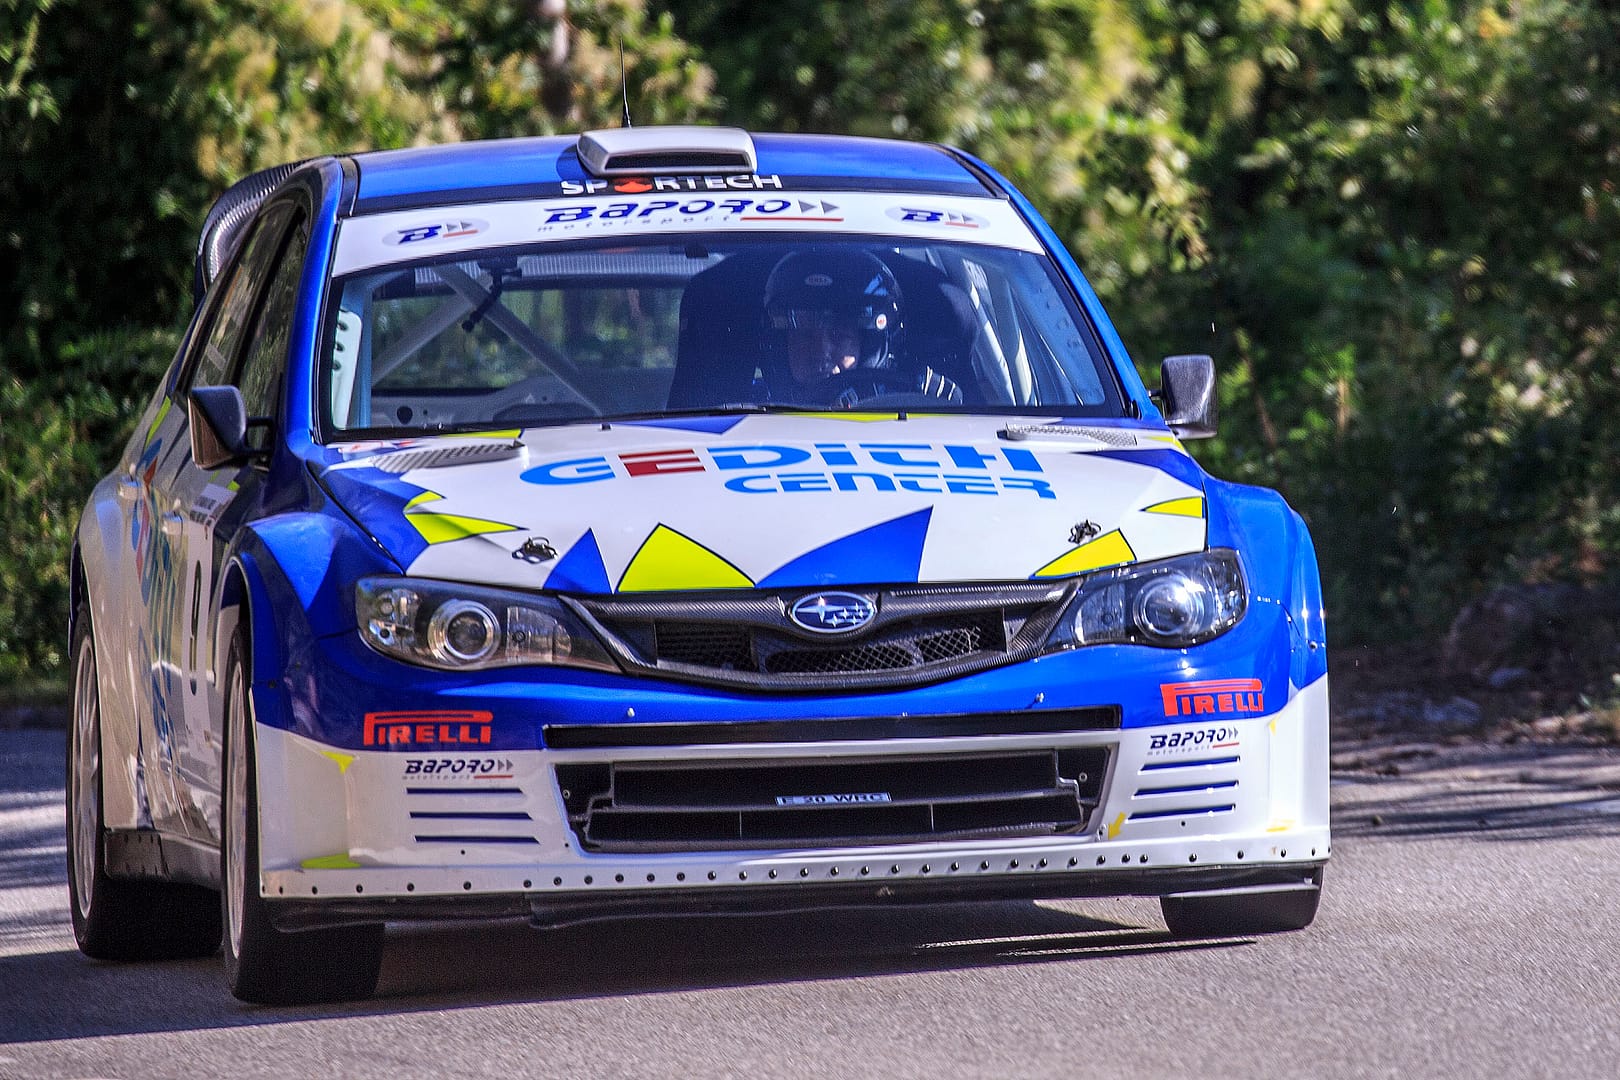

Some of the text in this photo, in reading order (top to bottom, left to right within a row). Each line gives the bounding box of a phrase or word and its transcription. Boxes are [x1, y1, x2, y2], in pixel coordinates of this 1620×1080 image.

[537, 214, 732, 233] motorsport
[1160, 678, 1264, 717] PIRELLI
[363, 709, 494, 746] PIRELLI
